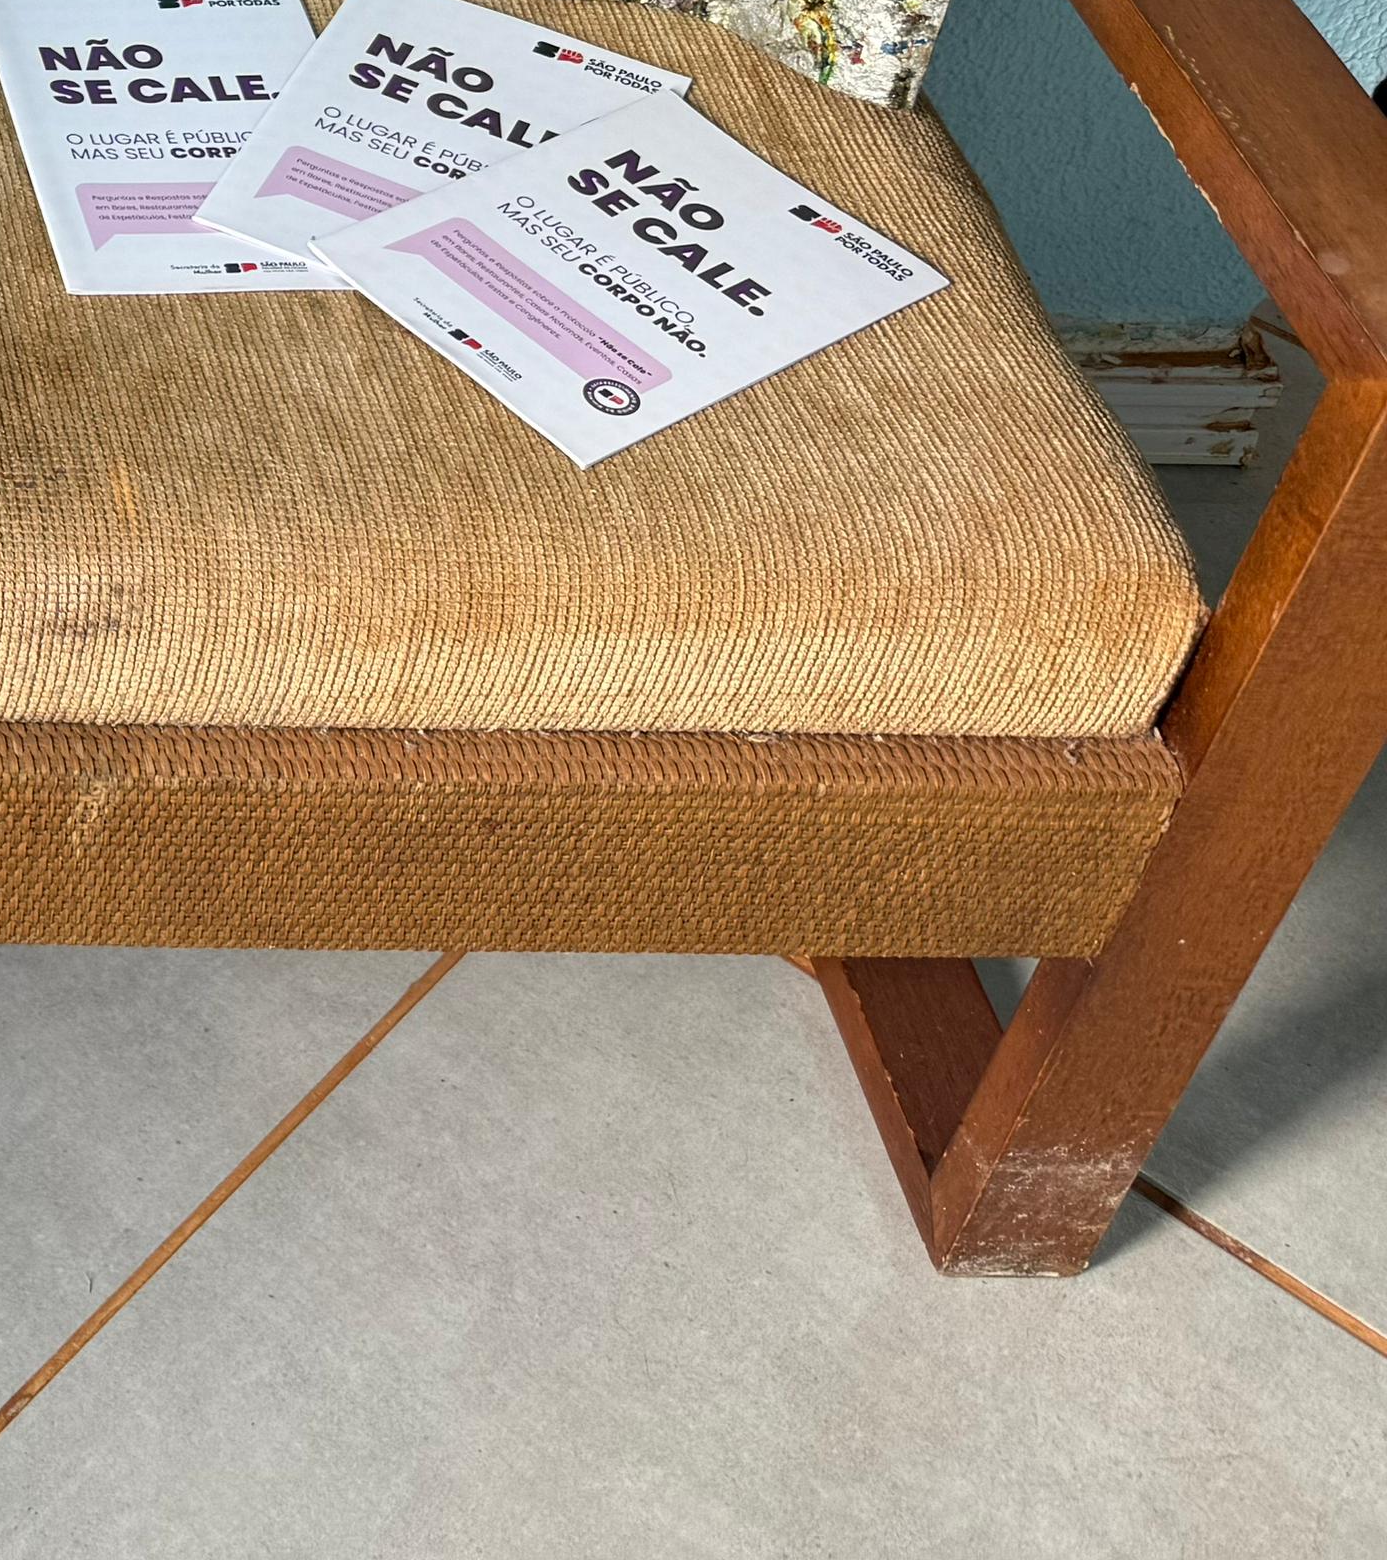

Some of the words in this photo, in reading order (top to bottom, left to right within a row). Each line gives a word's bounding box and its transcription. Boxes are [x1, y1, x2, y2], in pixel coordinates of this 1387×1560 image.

[38, 39, 163, 71] NÃO
[366, 33, 494, 93] NÃO
[588, 58, 616, 72] SÃO
[618, 68, 662, 88] PAULO
[50, 79, 117, 104] SE
[349, 63, 419, 103] SE
[584, 65, 612, 80] POR
[614, 75, 659, 94] TODAS
[66, 133, 83, 145] O
[89, 133, 160, 145] LUGAR
[165, 130, 178, 144] É
[315, 117, 363, 142] MAS
[368, 138, 409, 159] SEU
[324, 106, 341, 118] O
[346, 114, 417, 148] LUGAR
[421, 142, 436, 155] É
[71, 148, 119, 160] MAS
[124, 148, 164, 160] SEU
[170, 147, 241, 158] CORP
[604, 149, 724, 230] NÃO
[516, 196, 535, 208] O
[533, 210, 597, 256] LUGAR
[595, 255, 615, 266] É
[609, 265, 695, 328] PÚBLICO,
[567, 169, 640, 217] SE
[633, 217, 772, 316] CALE.
[835, 236, 863, 255] POR
[863, 252, 907, 281] TODAS
[843, 232, 872, 250] SÃO
[871, 249, 913, 277] PAULO
[497, 202, 543, 235] MAS
[540, 236, 581, 262] SEU
[578, 263, 655, 317] CORPO
[653, 317, 706, 358] NÃO.
